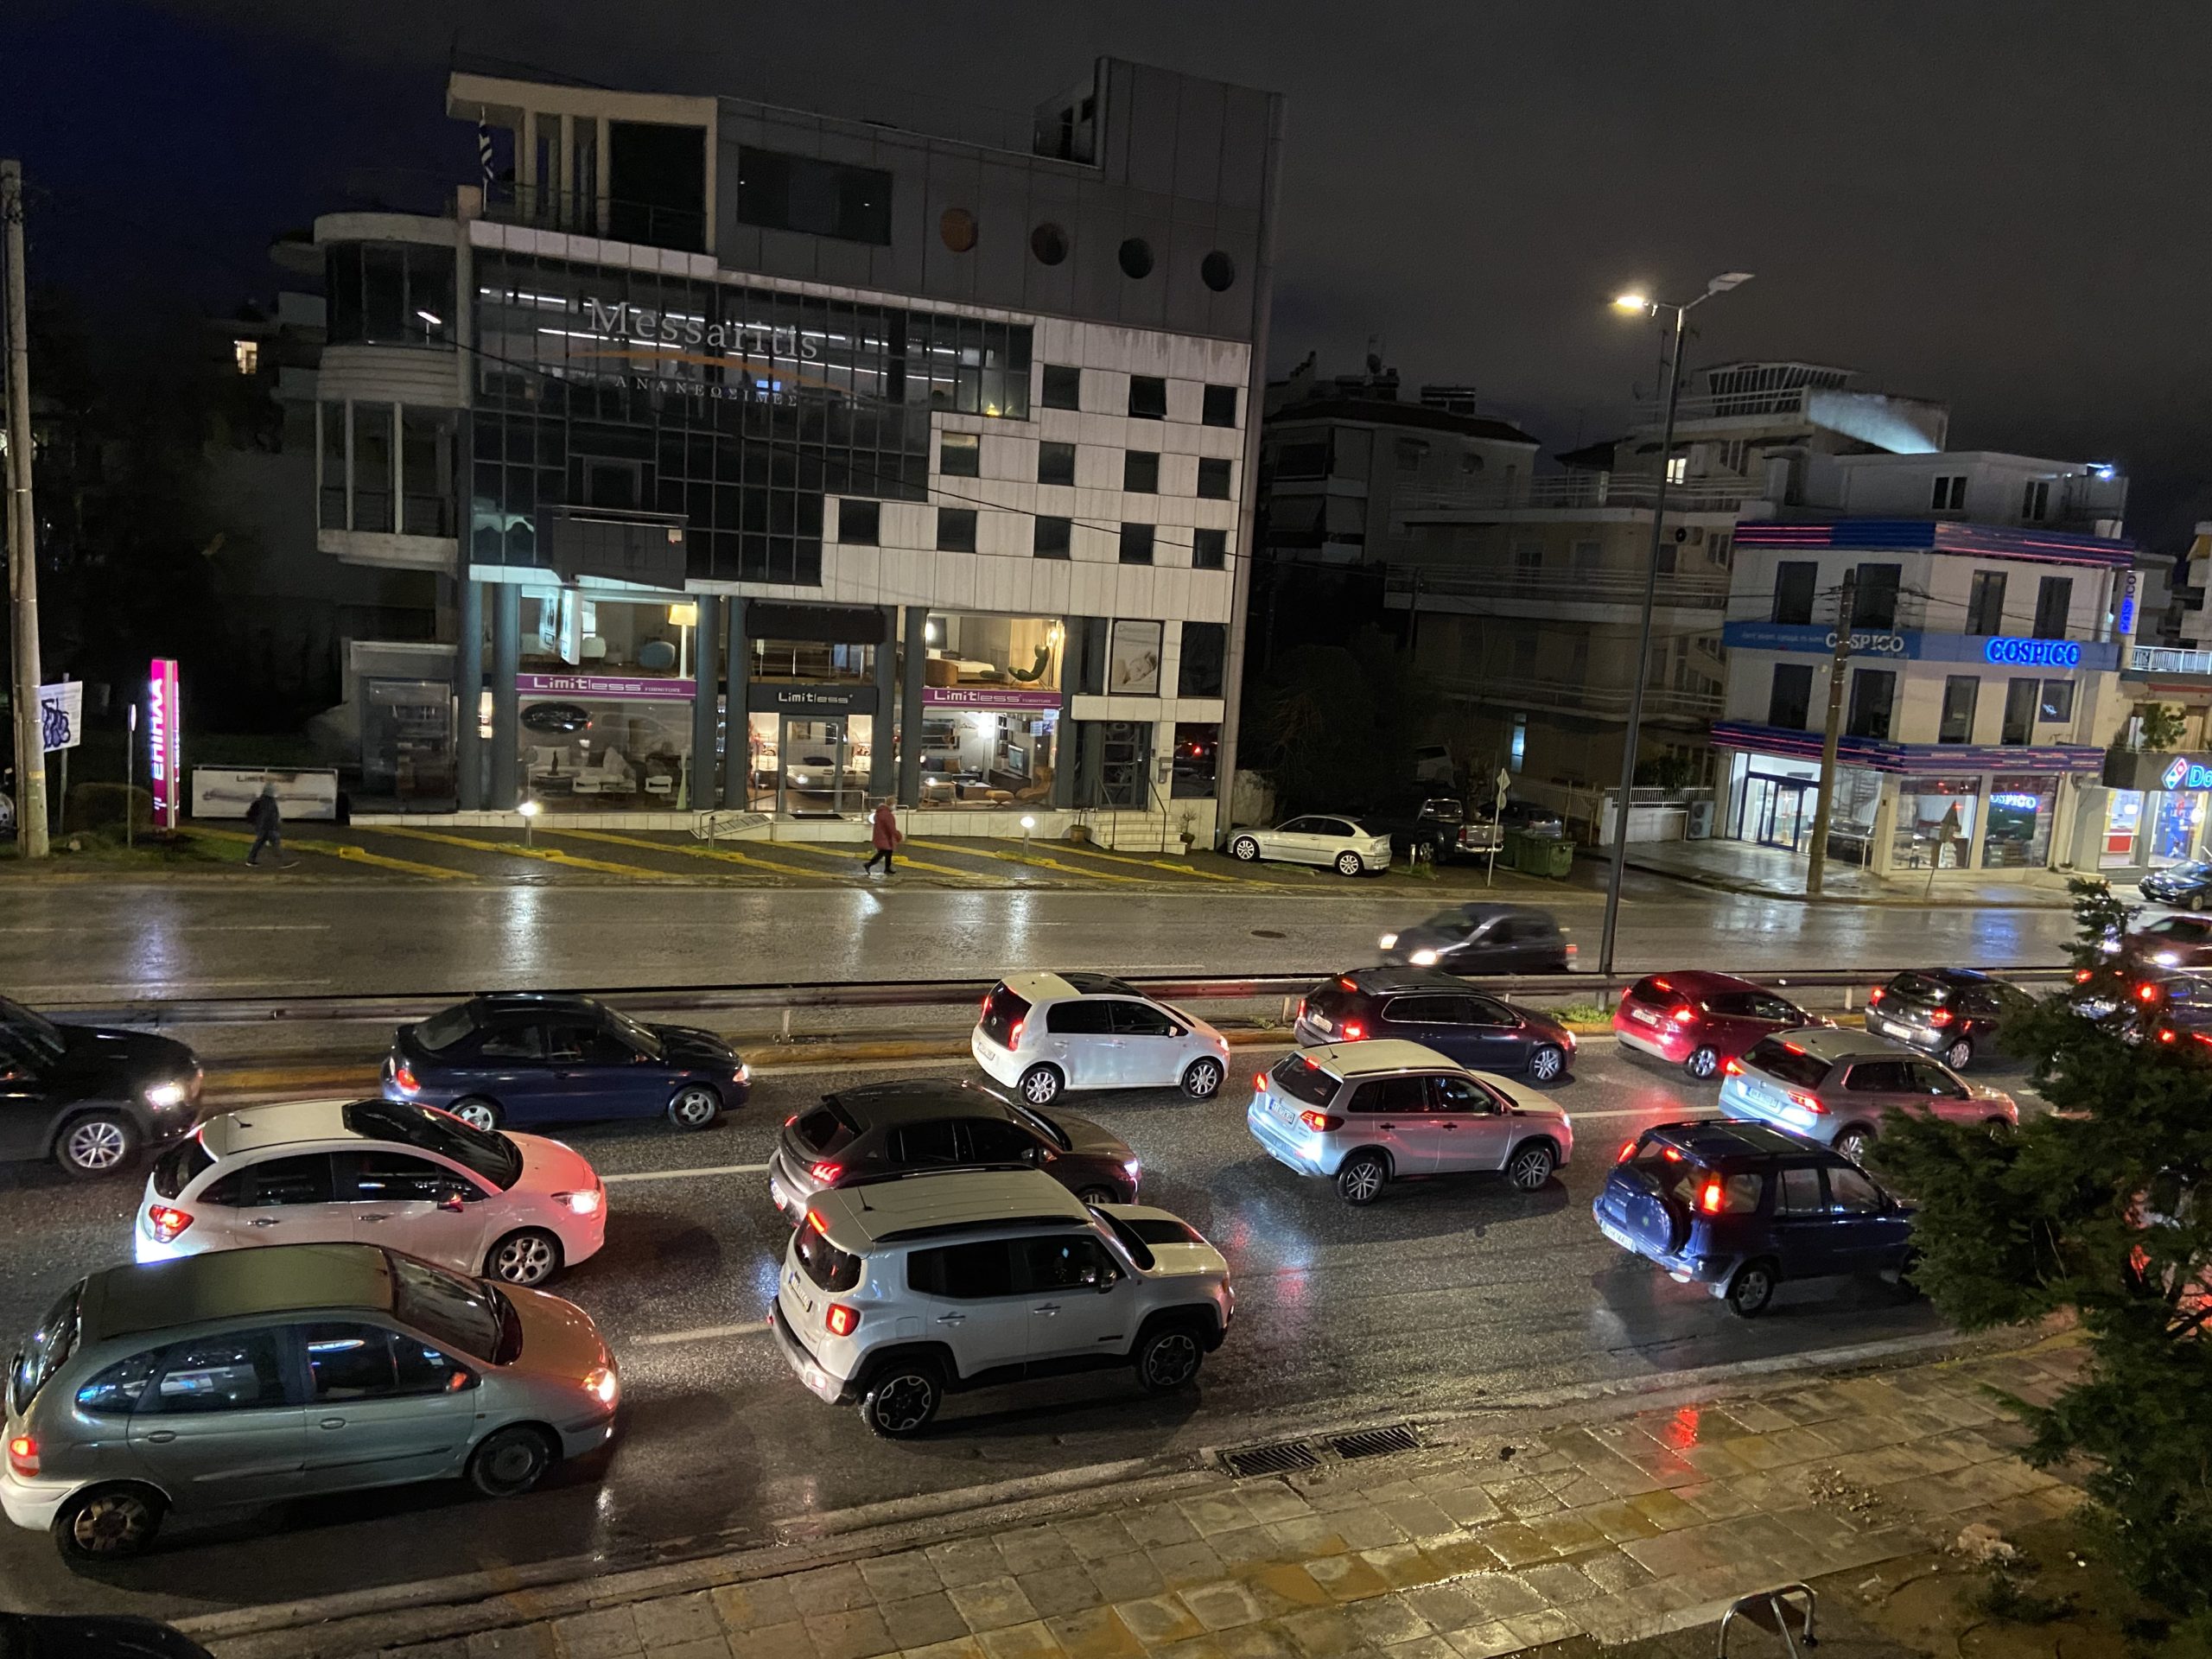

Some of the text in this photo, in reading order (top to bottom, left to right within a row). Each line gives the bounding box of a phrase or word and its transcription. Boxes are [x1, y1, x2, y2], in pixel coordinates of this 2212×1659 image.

[588, 296, 817, 359] Messaritis
[615, 375, 798, 407] ΑΝΑΝΕΩΣΙΜΕΣ
[1826, 632, 1904, 652] CSPICO
[1986, 638, 2082, 667] COSPICO
[533, 677, 642, 691] Limitless
[778, 691, 849, 704] Limitless
[934, 690, 1020, 702] Limitless
